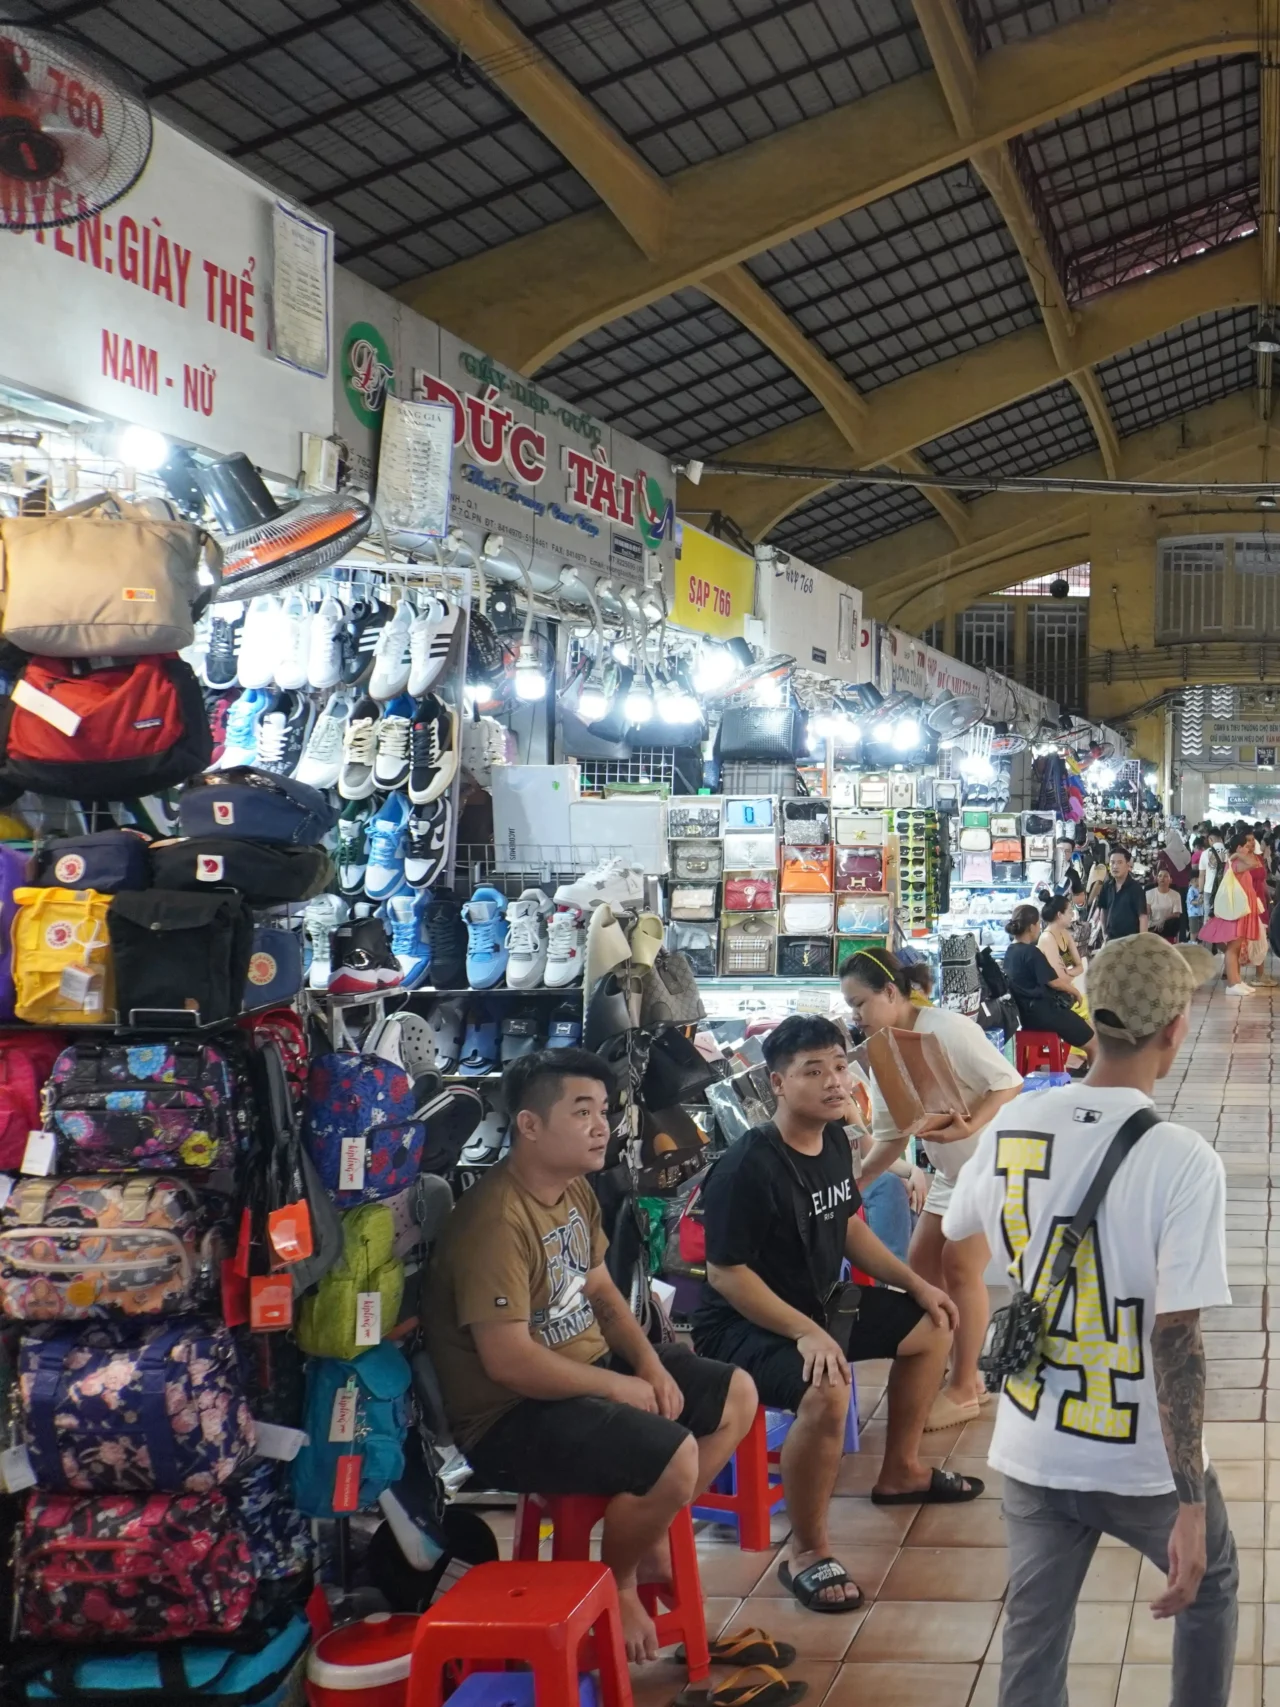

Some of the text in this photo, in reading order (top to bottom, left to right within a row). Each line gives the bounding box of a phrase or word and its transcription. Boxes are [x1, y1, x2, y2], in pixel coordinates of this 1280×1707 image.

[203, 255, 256, 343] THỂ
[101, 328, 158, 396] NAM
[566, 444, 636, 529] TÀI
[713, 585, 732, 618] 766
[800, 574, 814, 594] 768
[809, 1178, 852, 1217] ELINE
[823, 1211, 835, 1221] RIS
